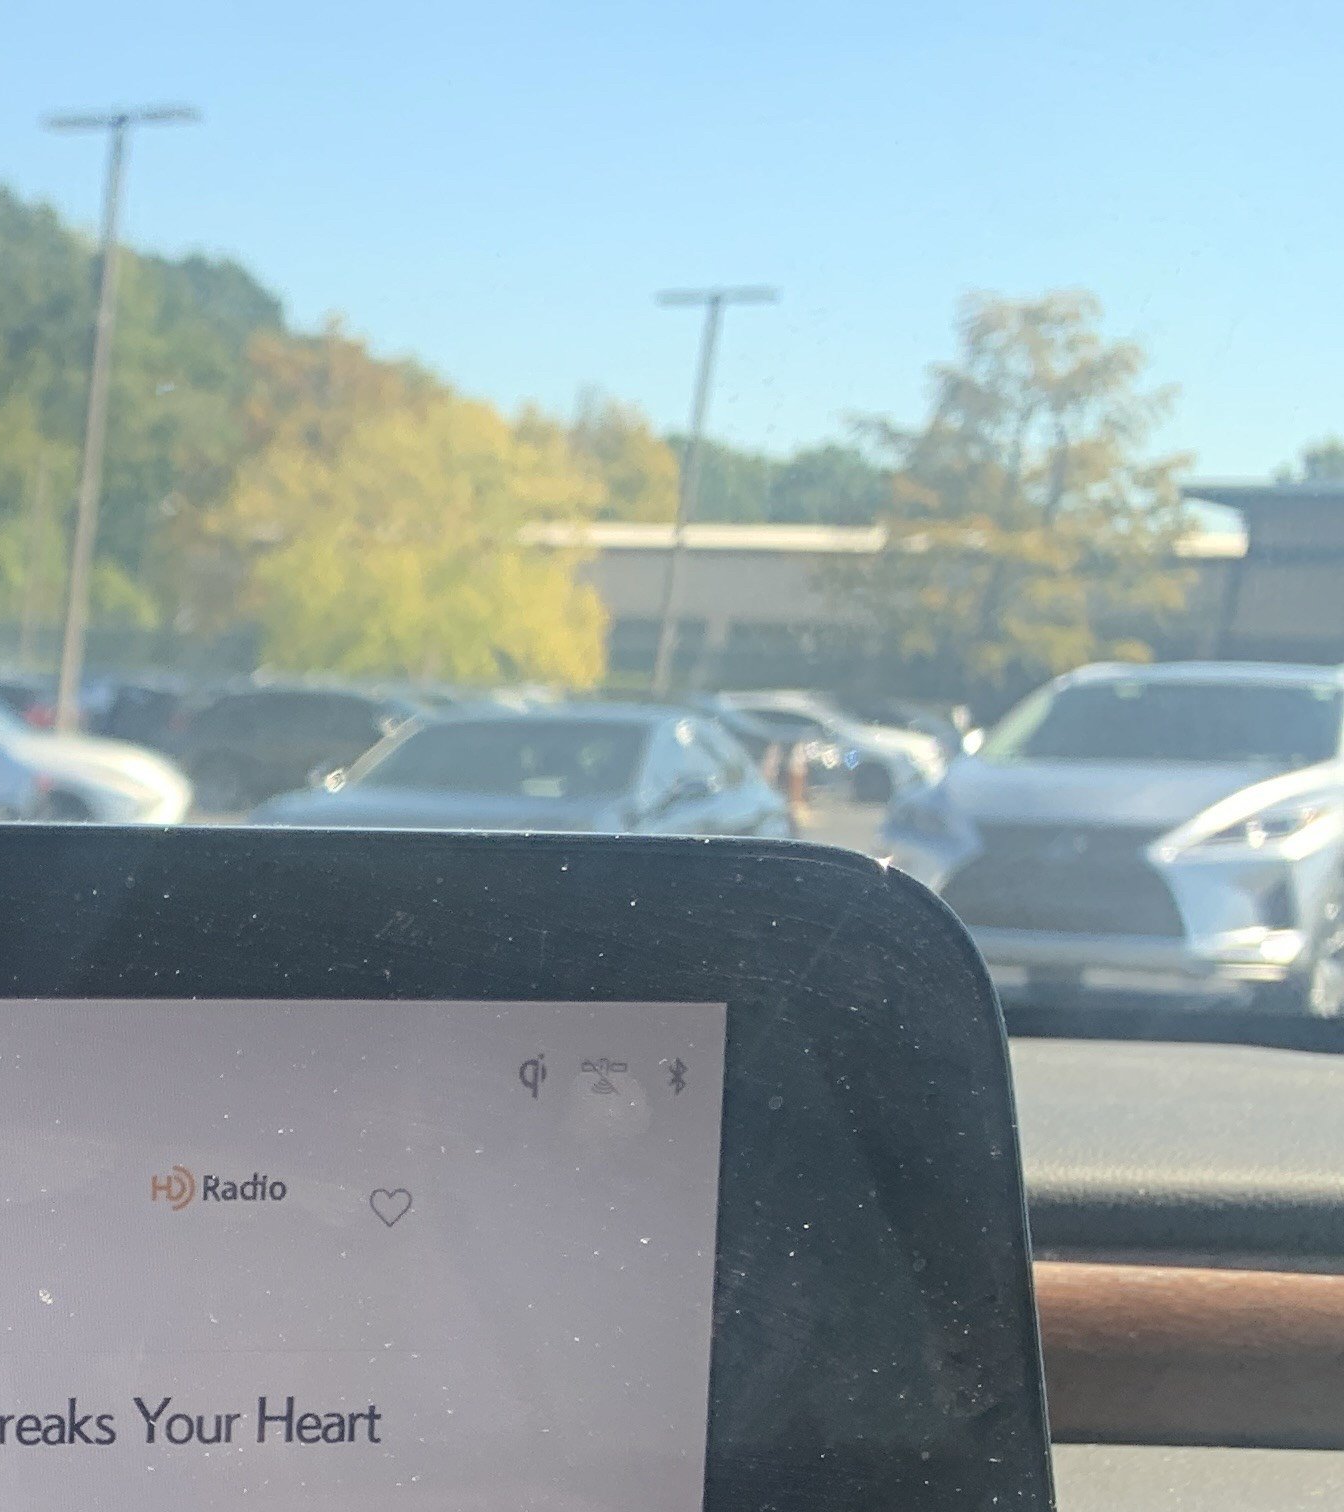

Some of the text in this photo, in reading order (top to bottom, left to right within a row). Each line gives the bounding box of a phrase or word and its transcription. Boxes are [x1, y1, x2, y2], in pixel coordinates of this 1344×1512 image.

[202, 1172, 288, 1202] Radio
[132, 1396, 242, 1445] Your
[256, 1395, 383, 1445] Heart
